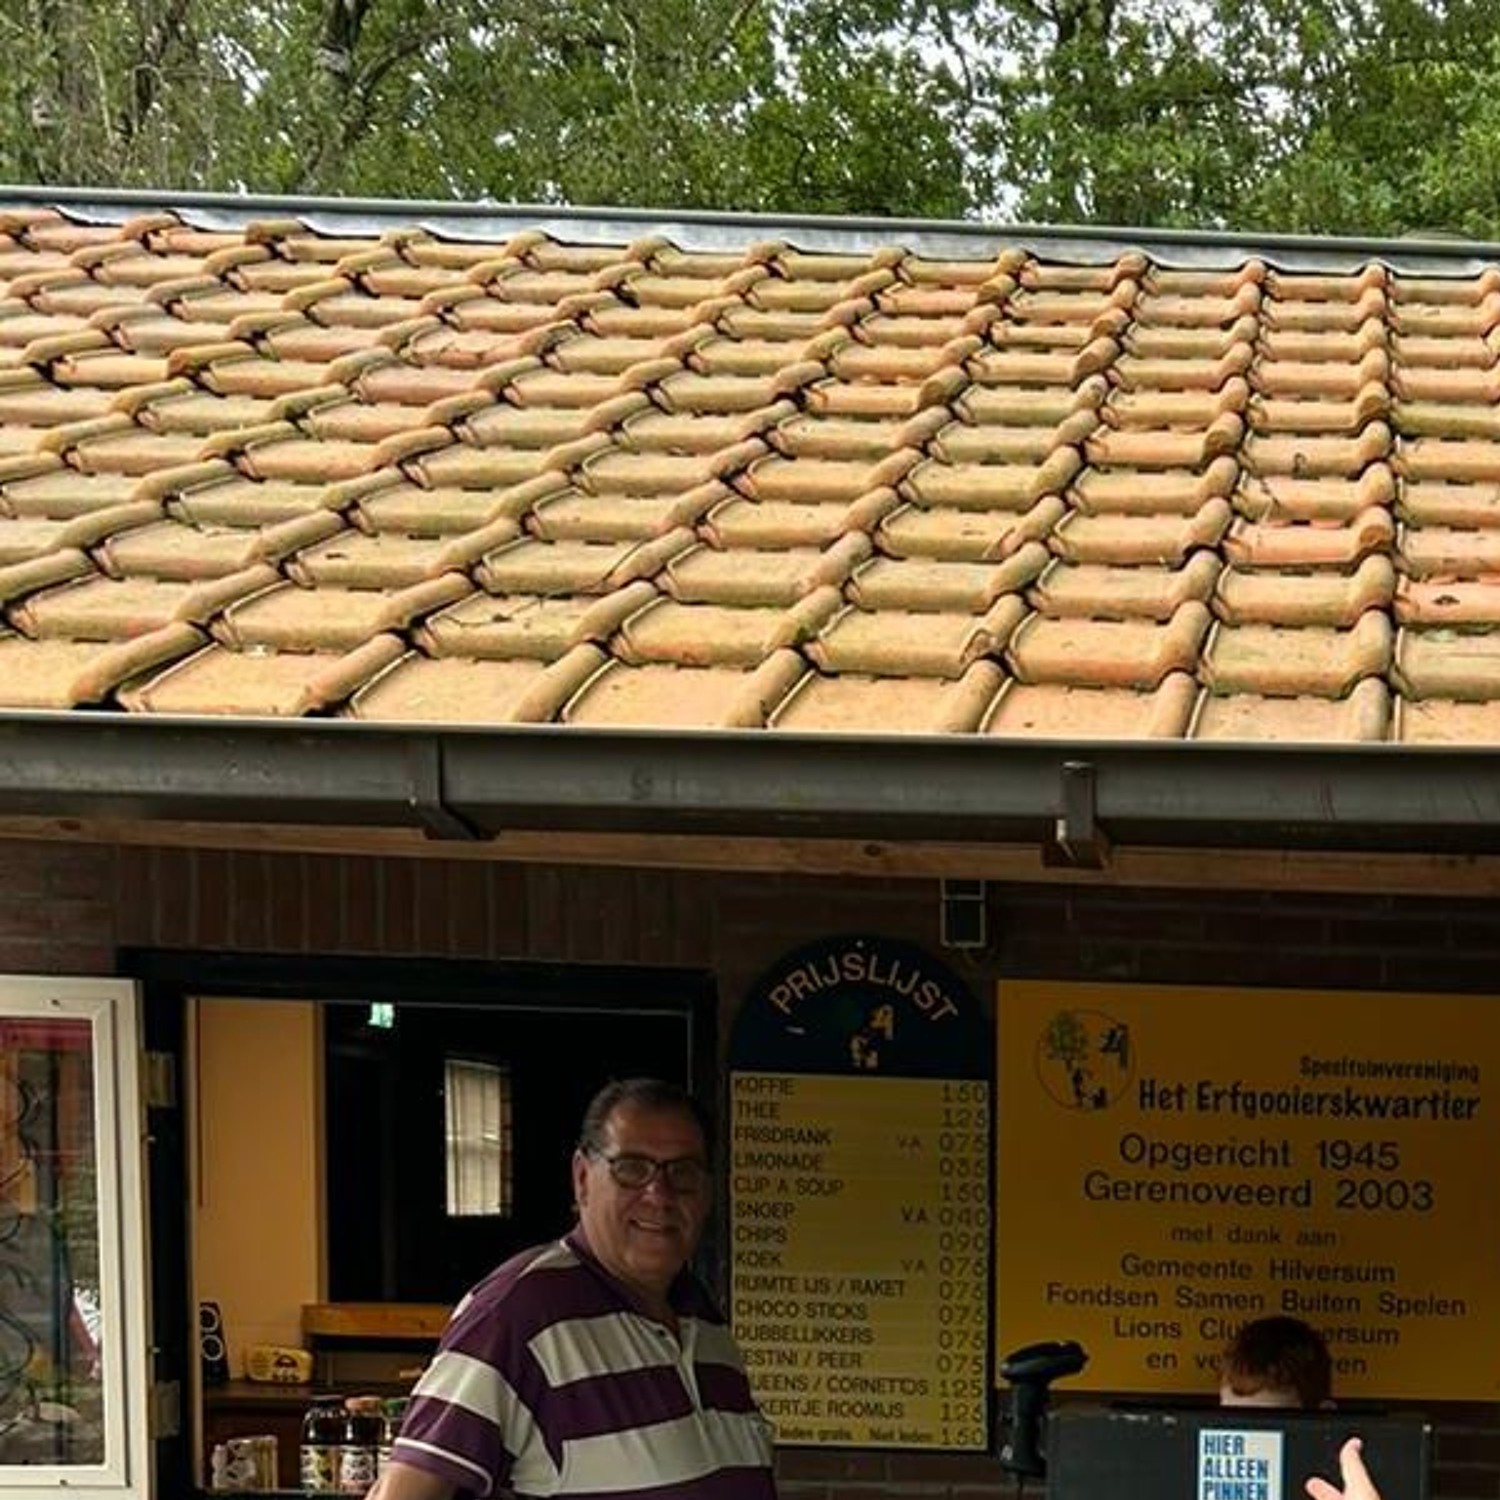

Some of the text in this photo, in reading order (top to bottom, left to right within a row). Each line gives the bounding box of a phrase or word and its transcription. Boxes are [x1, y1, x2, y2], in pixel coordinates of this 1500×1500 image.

[769, 953, 958, 1021] PRIJSLIJST
[1300, 1055, 1480, 1083] Speeltuinvereniging
[735, 1078, 795, 1095] KOFFIE
[737, 1101, 780, 1119] THEE
[1139, 1079, 1481, 1121] Het Erfgooierskwartier
[735, 1128, 832, 1146] FRISDRANK
[1119, 1133, 1400, 1171] Opgericht 1945
[735, 1153, 823, 1172] LIMONADE
[735, 1177, 771, 1194] CUP
[776, 1179, 789, 1194] A
[797, 1178, 844, 1196] SOUP
[1083, 1171, 1434, 1211] Gerenoveerd 2003
[735, 1201, 796, 1219] SNOEP
[735, 1226, 787, 1244] CHIPS
[1171, 1224, 1213, 1246] met
[1227, 1225, 1281, 1246] dank
[735, 1252, 781, 1269] KOEK
[1121, 1253, 1397, 1284] Gemeente Hilversum
[735, 1277, 797, 1294] RUIMTE
[851, 1280, 905, 1297] RAKET
[735, 1301, 798, 1319] CHOCO
[806, 1302, 868, 1320] STICKS
[1047, 1283, 1466, 1319] Fondsen Samen Buiten Spelen
[735, 1325, 874, 1345] DUBBELLIKKERS
[1113, 1317, 1181, 1340] Lions
[1199, 1317, 1246, 1342] Clu
[743, 1351, 798, 1368] ESTINI
[817, 1352, 862, 1369] PEER
[1147, 1354, 1178, 1370] en
[752, 1376, 810, 1394] UEENS
[826, 1377, 930, 1397] CORNETTOS
[759, 1400, 822, 1418] KERTJE
[827, 1402, 905, 1420] ROOMIJS
[1204, 1435, 1244, 1455] HIER
[1203, 1457, 1268, 1478] ALLEEN
